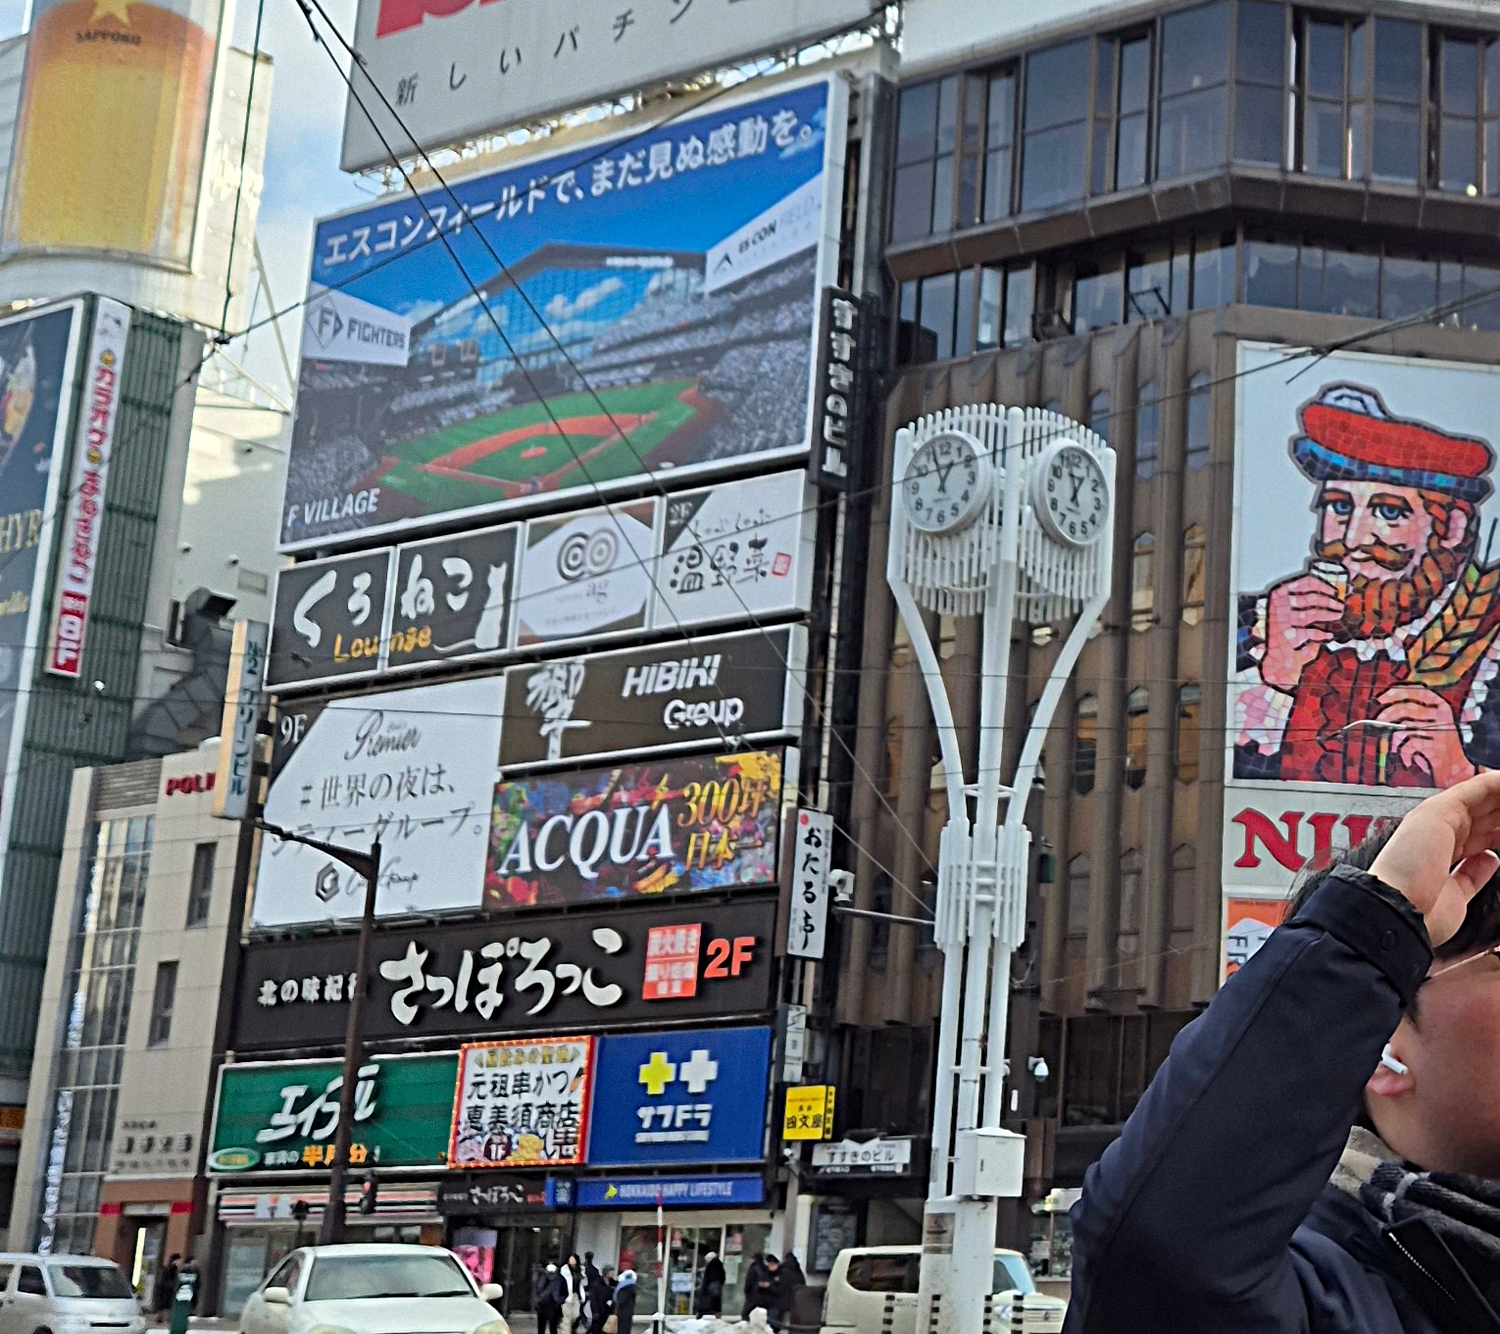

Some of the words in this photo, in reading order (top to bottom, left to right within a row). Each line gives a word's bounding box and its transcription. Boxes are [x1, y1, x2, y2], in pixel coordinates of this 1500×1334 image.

[75, 30, 142, 46] SAPPORO
[323, 107, 813, 267] エスコンフィールドで、まだ見ぬ感動を。
[346, 317, 407, 350] FIGHTERS
[304, 488, 380, 524] VILLAGE
[294, 555, 473, 648] くろねこ
[333, 625, 432, 662] Lounge
[621, 654, 722, 698] HIBIKI
[663, 697, 745, 730] Group
[495, 802, 675, 881] ACQUA
[685, 827, 764, 870] 日本一
[703, 936, 756, 979] 2F
[379, 927, 625, 1026] さっぽろっこ
[466, 1068, 571, 1101] 元祖串かつ
[827, 1150, 895, 1164] すすきのビル
[662, 1182, 689, 1197] HAPPY
[690, 1181, 733, 1197] LIFESTYLE
